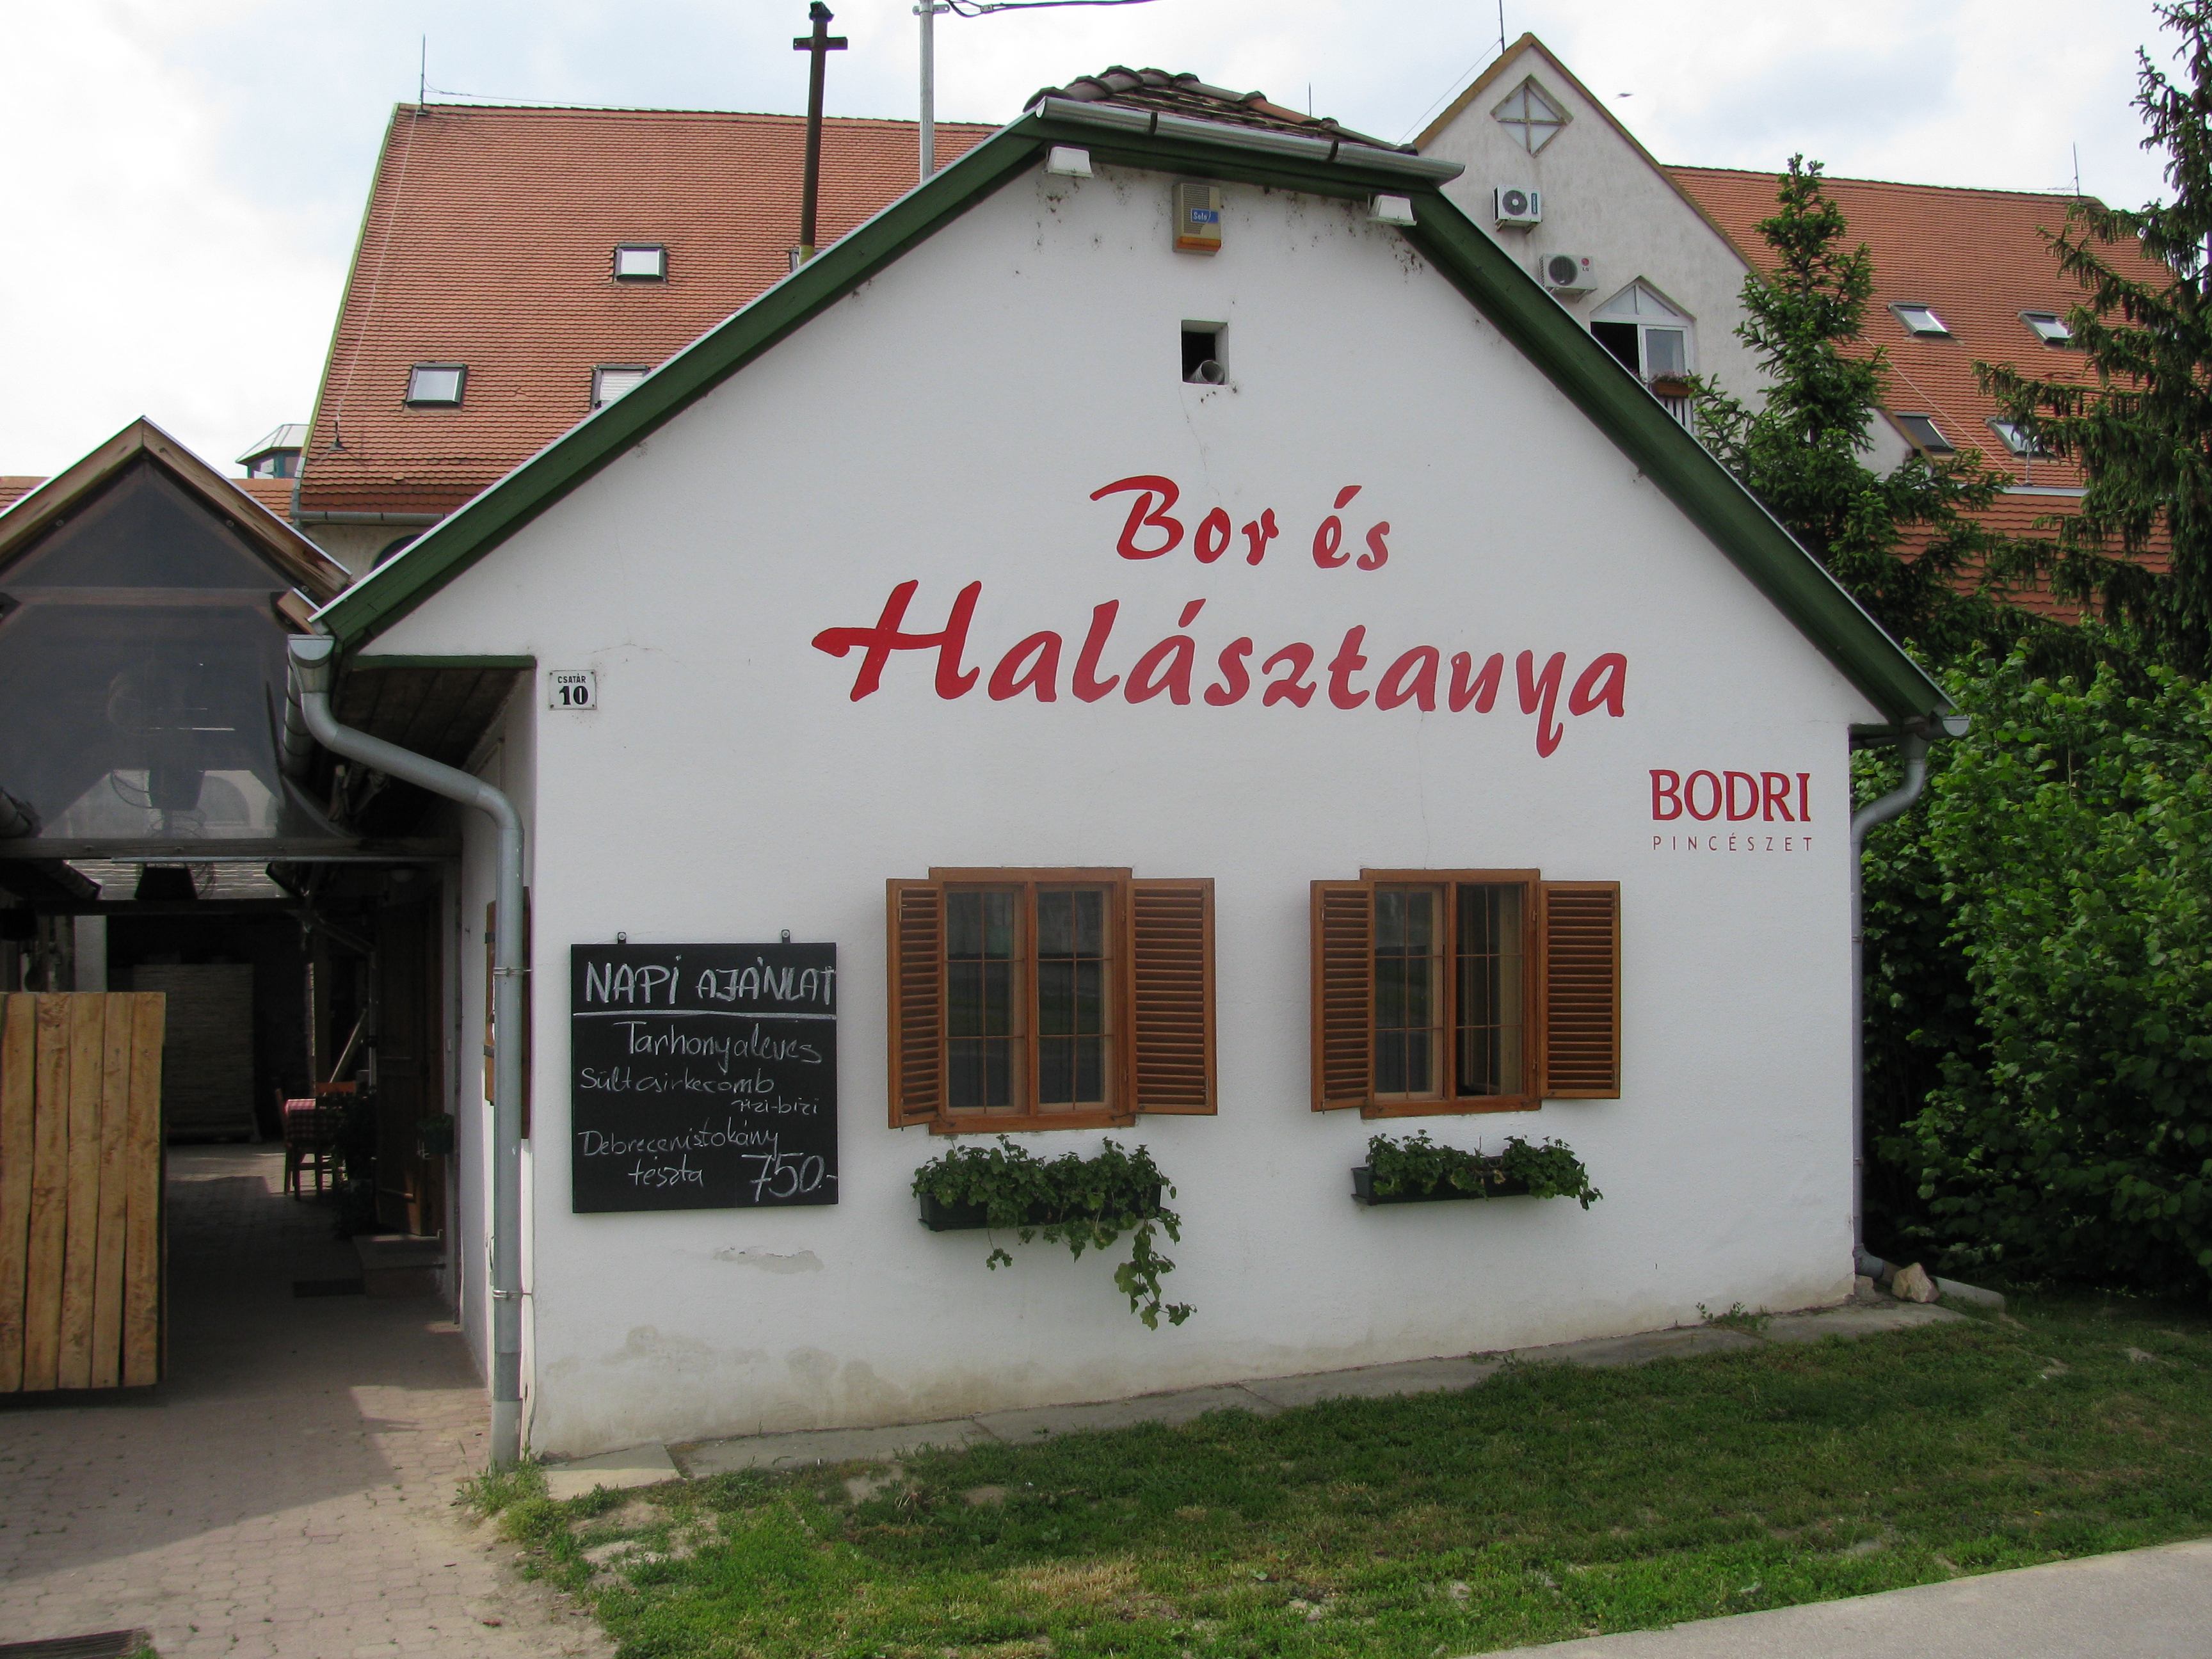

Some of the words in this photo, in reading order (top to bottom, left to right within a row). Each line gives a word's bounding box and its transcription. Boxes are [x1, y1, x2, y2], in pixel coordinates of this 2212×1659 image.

[1089, 475, 1279, 565] Bor
[1312, 485, 1390, 571] és
[557, 673, 586, 684] CSATÁR
[812, 579, 1627, 758] Halásztanya
[559, 685, 589, 705] 10
[1649, 769, 1811, 822] BODRI
[1653, 833, 1812, 851] PINCÉSZET
[695, 956, 835, 1005] AJÁNLAT
[613, 1021, 822, 1075] Tarhonyaleves
